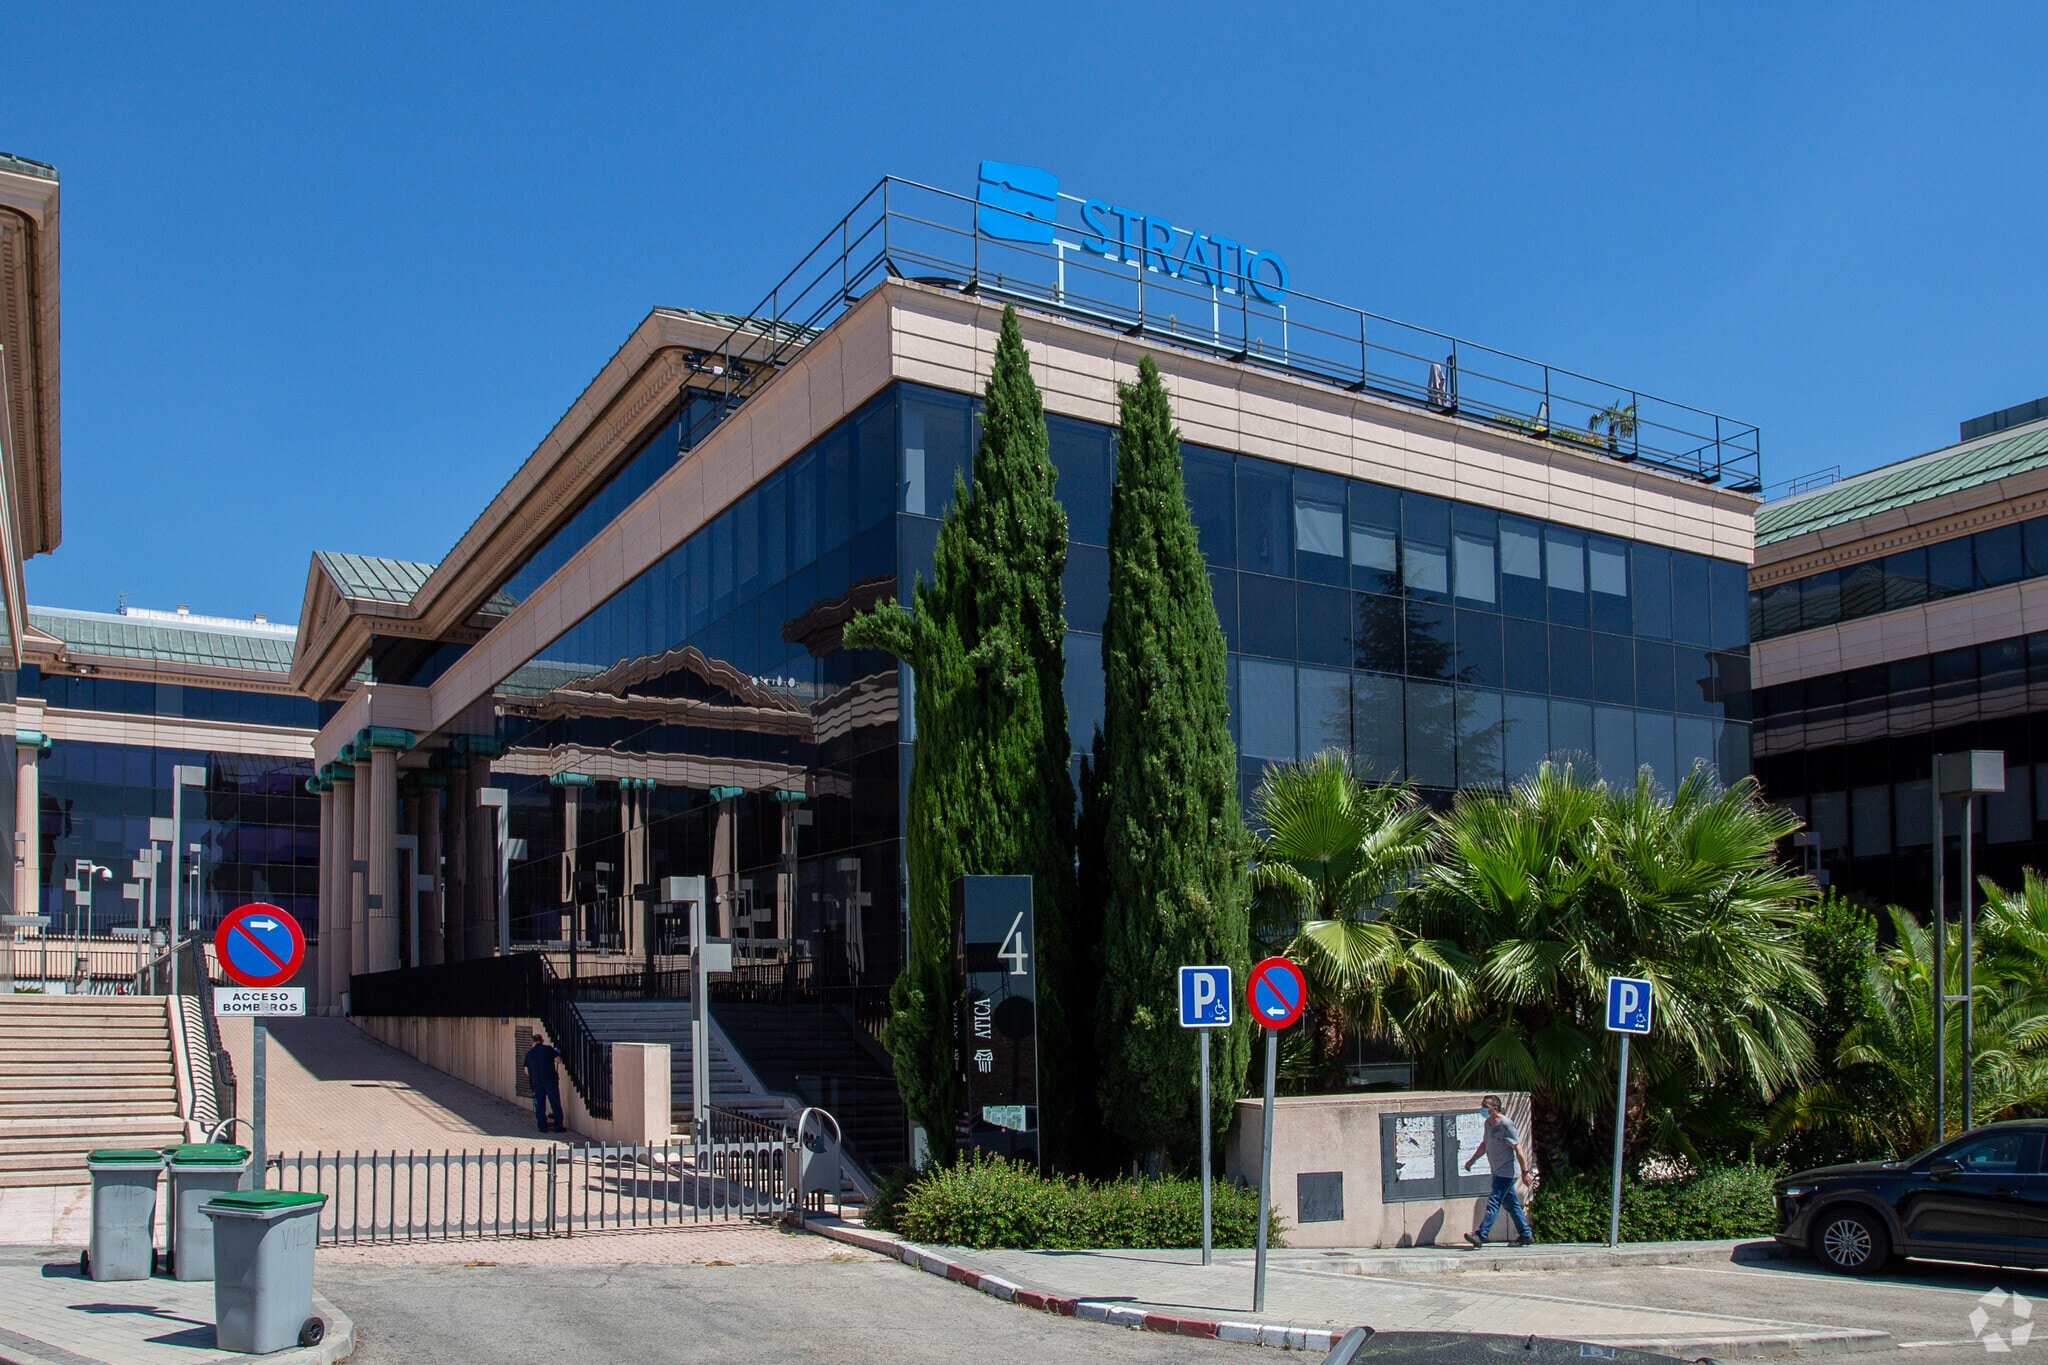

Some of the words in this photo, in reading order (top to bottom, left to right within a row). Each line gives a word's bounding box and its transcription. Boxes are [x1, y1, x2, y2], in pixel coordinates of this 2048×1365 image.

[1080, 198, 1289, 303] STRATIO
[997, 911, 1028, 975] 4
[222, 1003, 298, 1012] BOMBROS
[232, 992, 289, 1001] ACCESO
[1193, 972, 1216, 1019] P
[1618, 983, 1639, 1025] P
[974, 997, 992, 1040] ATICA
